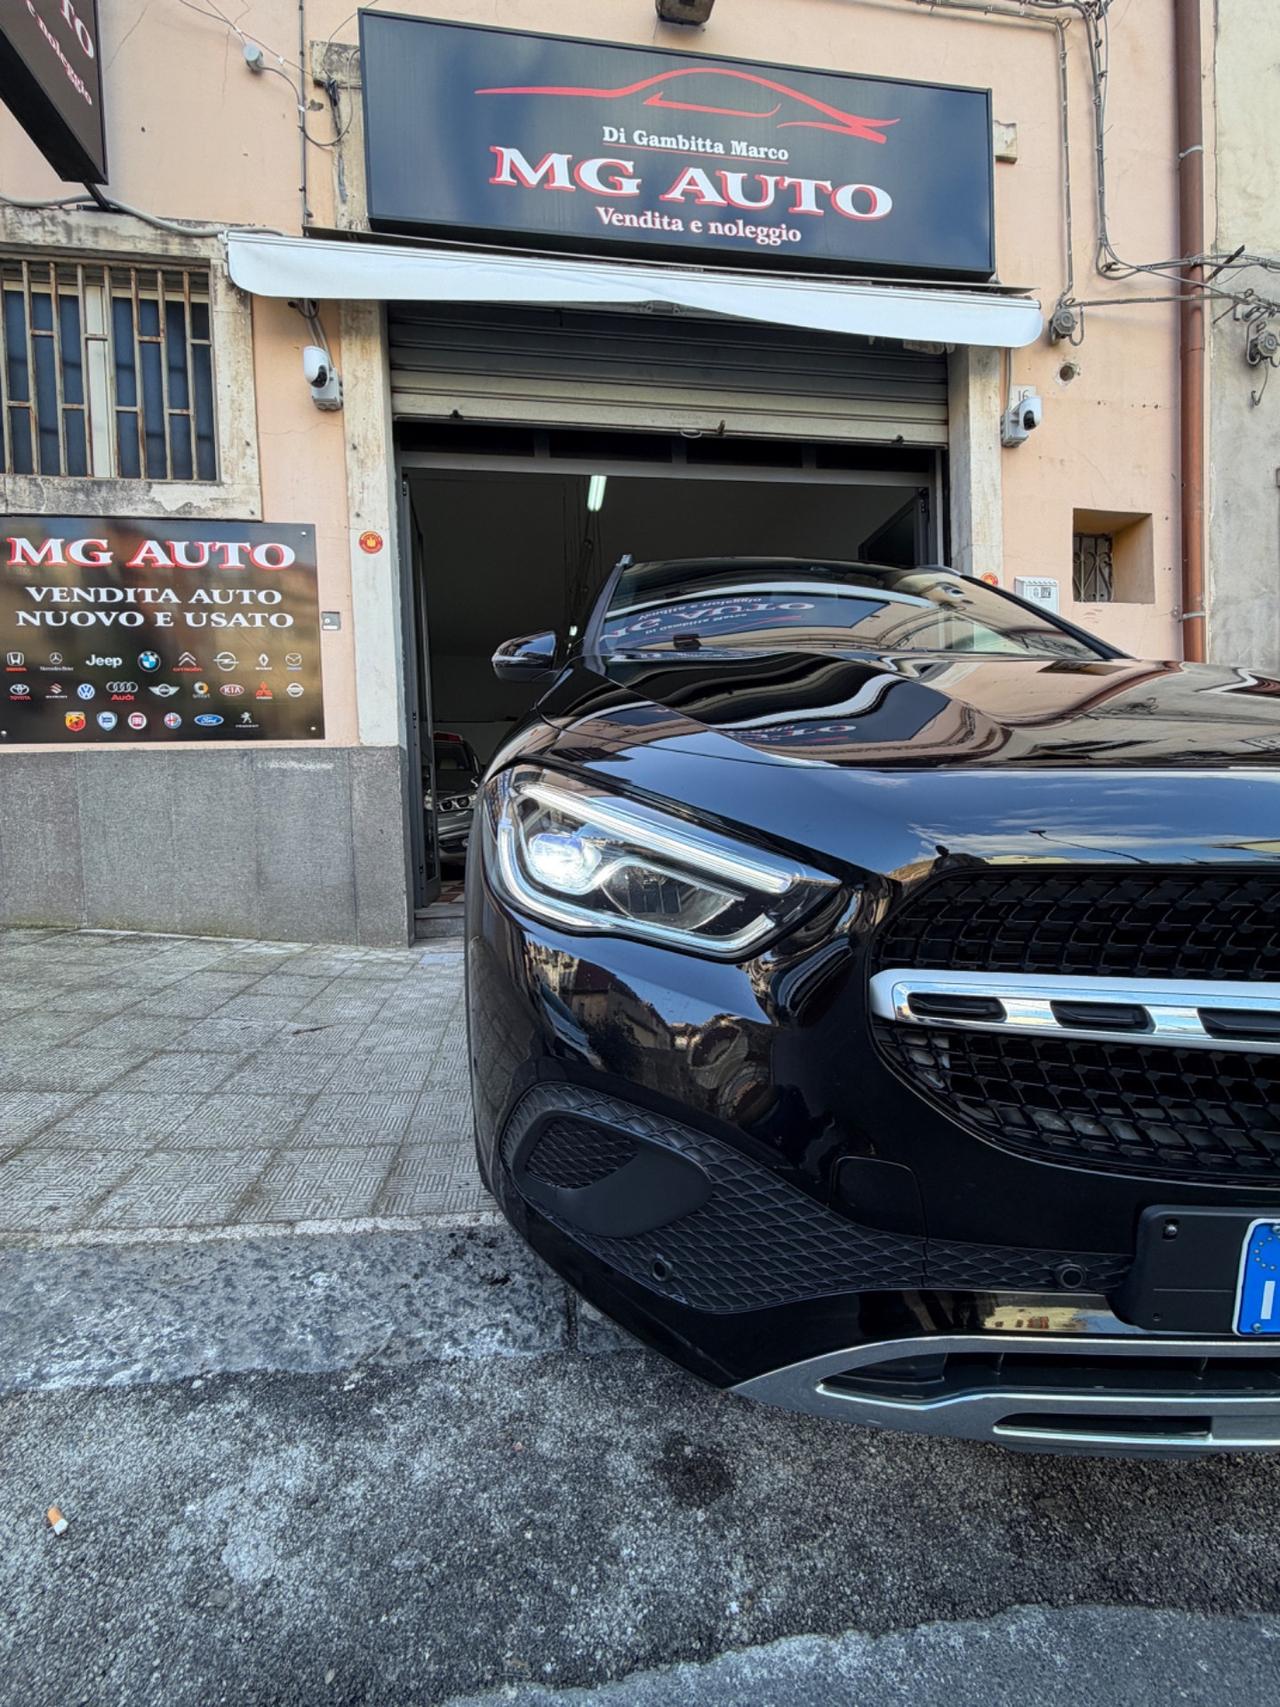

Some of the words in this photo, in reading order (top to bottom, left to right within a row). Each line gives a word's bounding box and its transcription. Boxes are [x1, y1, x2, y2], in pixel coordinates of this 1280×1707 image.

[602, 126, 628, 146] Di
[633, 129, 725, 156] Gambitta
[730, 138, 789, 161] Marco
[488, 144, 641, 198] MG
[661, 166, 894, 221] AUTO
[595, 206, 685, 233] Vendita
[691, 220, 703, 234] e
[708, 217, 802, 247] noleggio
[6, 536, 114, 567] MG
[125, 540, 296, 570] AUTO
[25, 586, 182, 604] VENDITA
[187, 588, 283, 605] AUTO
[15, 610, 145, 627] NUOVO
[154, 611, 175, 627] E
[183, 612, 294, 629] USATO
[85, 654, 123, 668] Jeep
[110, 694, 135, 702] Audi
[223, 686, 242, 694] KIA
[1260, 1280, 1276, 1320] I
